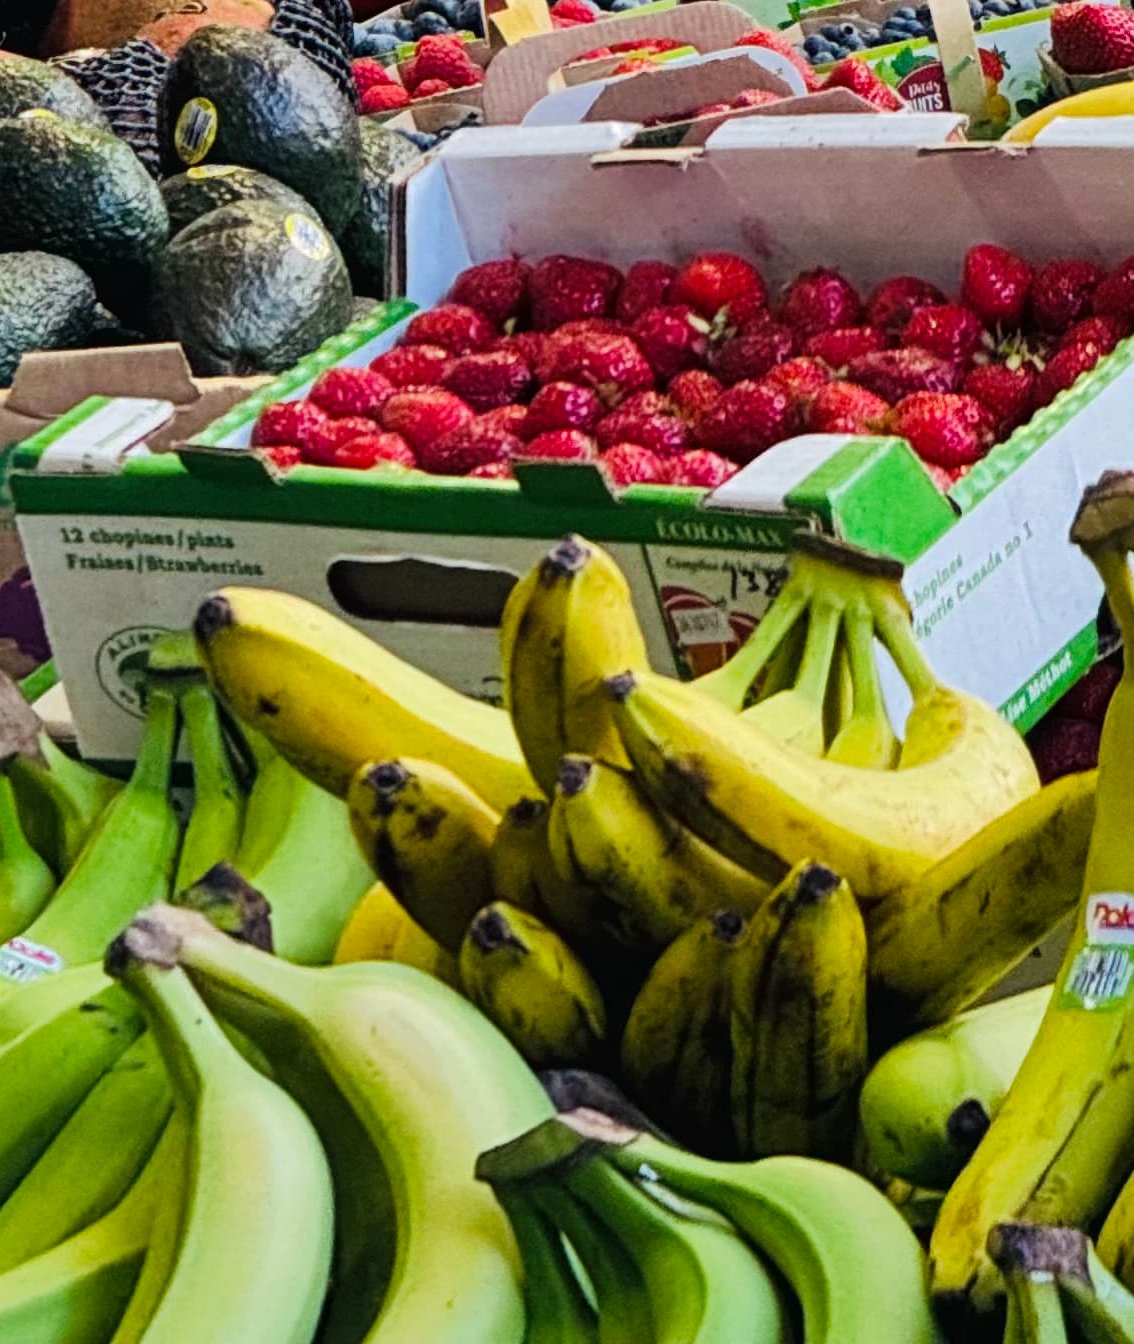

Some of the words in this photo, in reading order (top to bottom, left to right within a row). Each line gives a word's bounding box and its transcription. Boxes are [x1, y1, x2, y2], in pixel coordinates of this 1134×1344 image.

[60, 527, 84, 543] 12
[912, 553, 963, 608] hopines
[956, 551, 1002, 600] Canada
